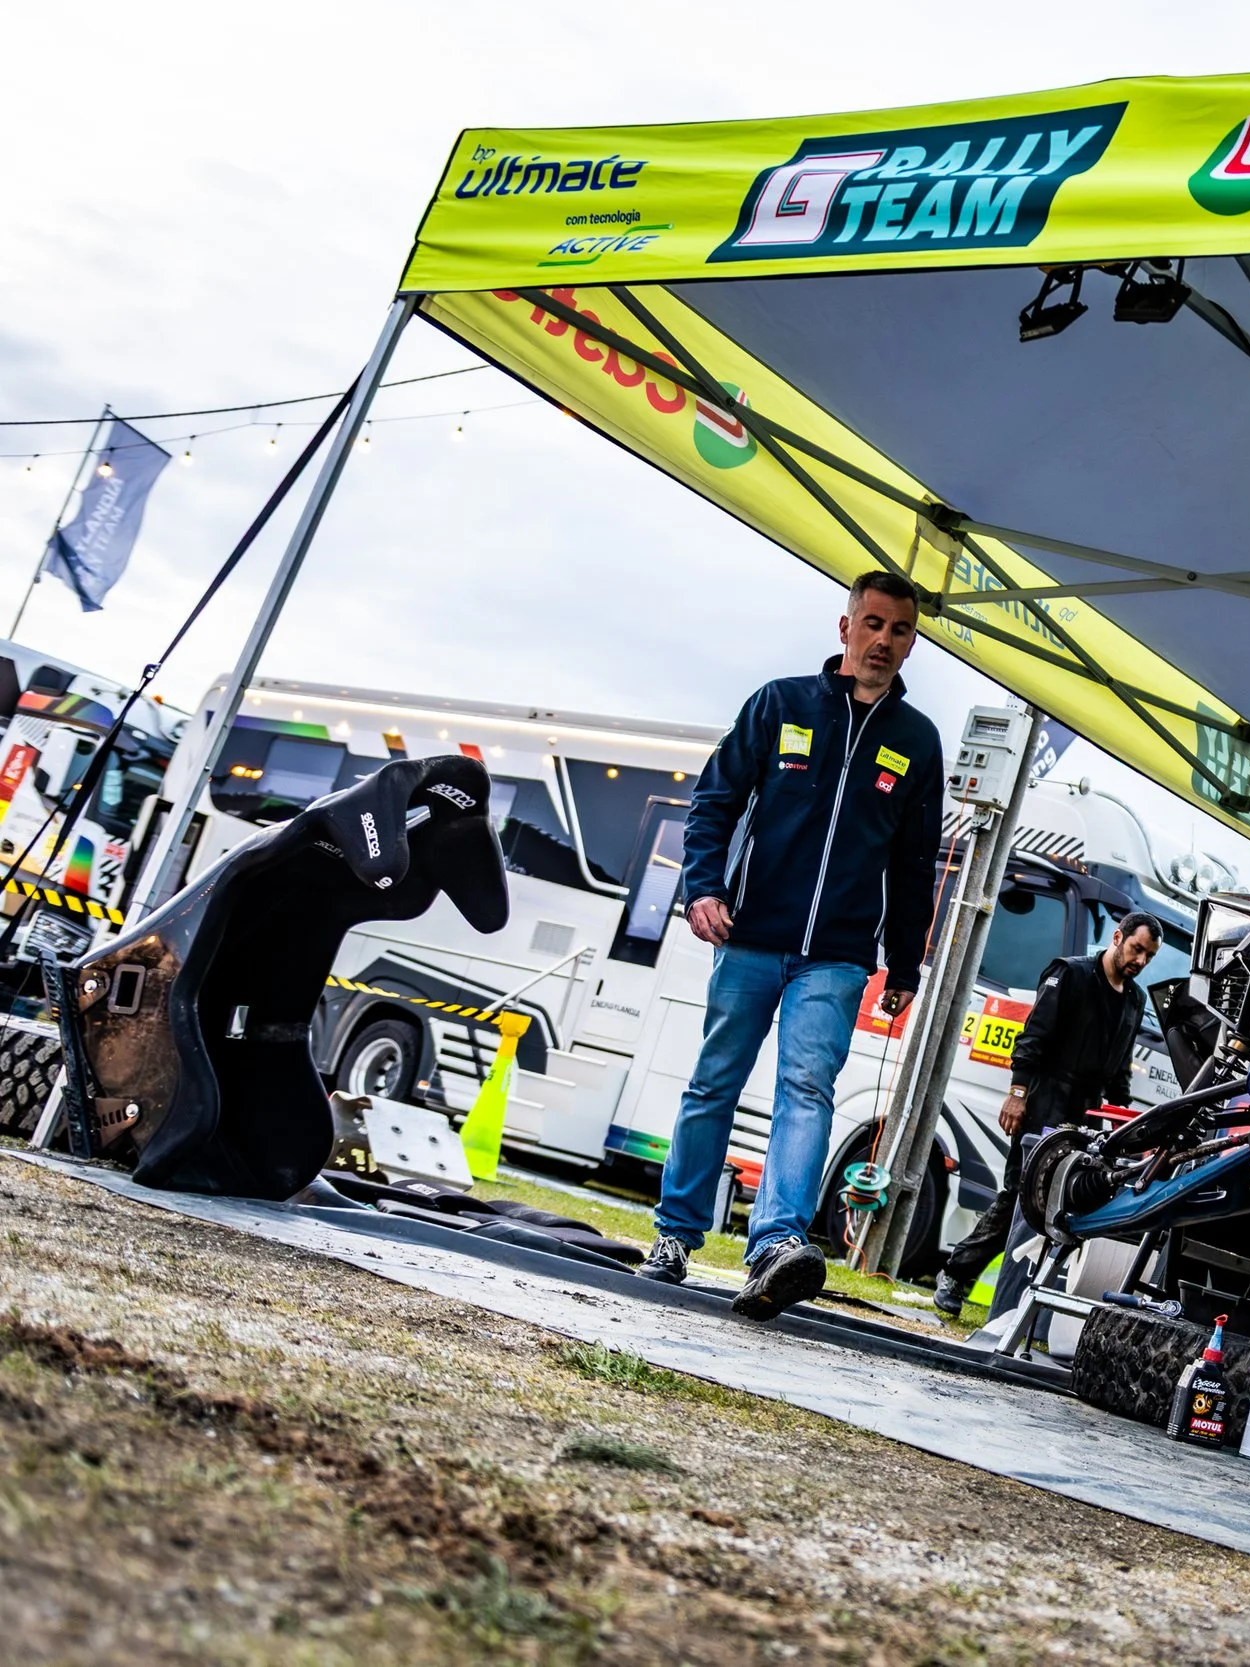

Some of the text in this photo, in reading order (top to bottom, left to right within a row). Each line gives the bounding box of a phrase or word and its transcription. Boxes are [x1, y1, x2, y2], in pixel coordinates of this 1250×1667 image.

[471, 144, 496, 165] bp
[857, 123, 1103, 179] RALLY
[455, 154, 648, 199] ultimate
[566, 209, 641, 225] com tecnologia
[836, 175, 1039, 244] TEAM
[547, 235, 660, 255] ACTIVE
[426, 783, 477, 810] sparco
[361, 812, 381, 859] sparco
[981, 1023, 1025, 1052] 135
[1192, 1419, 1222, 1433] MOTUL
